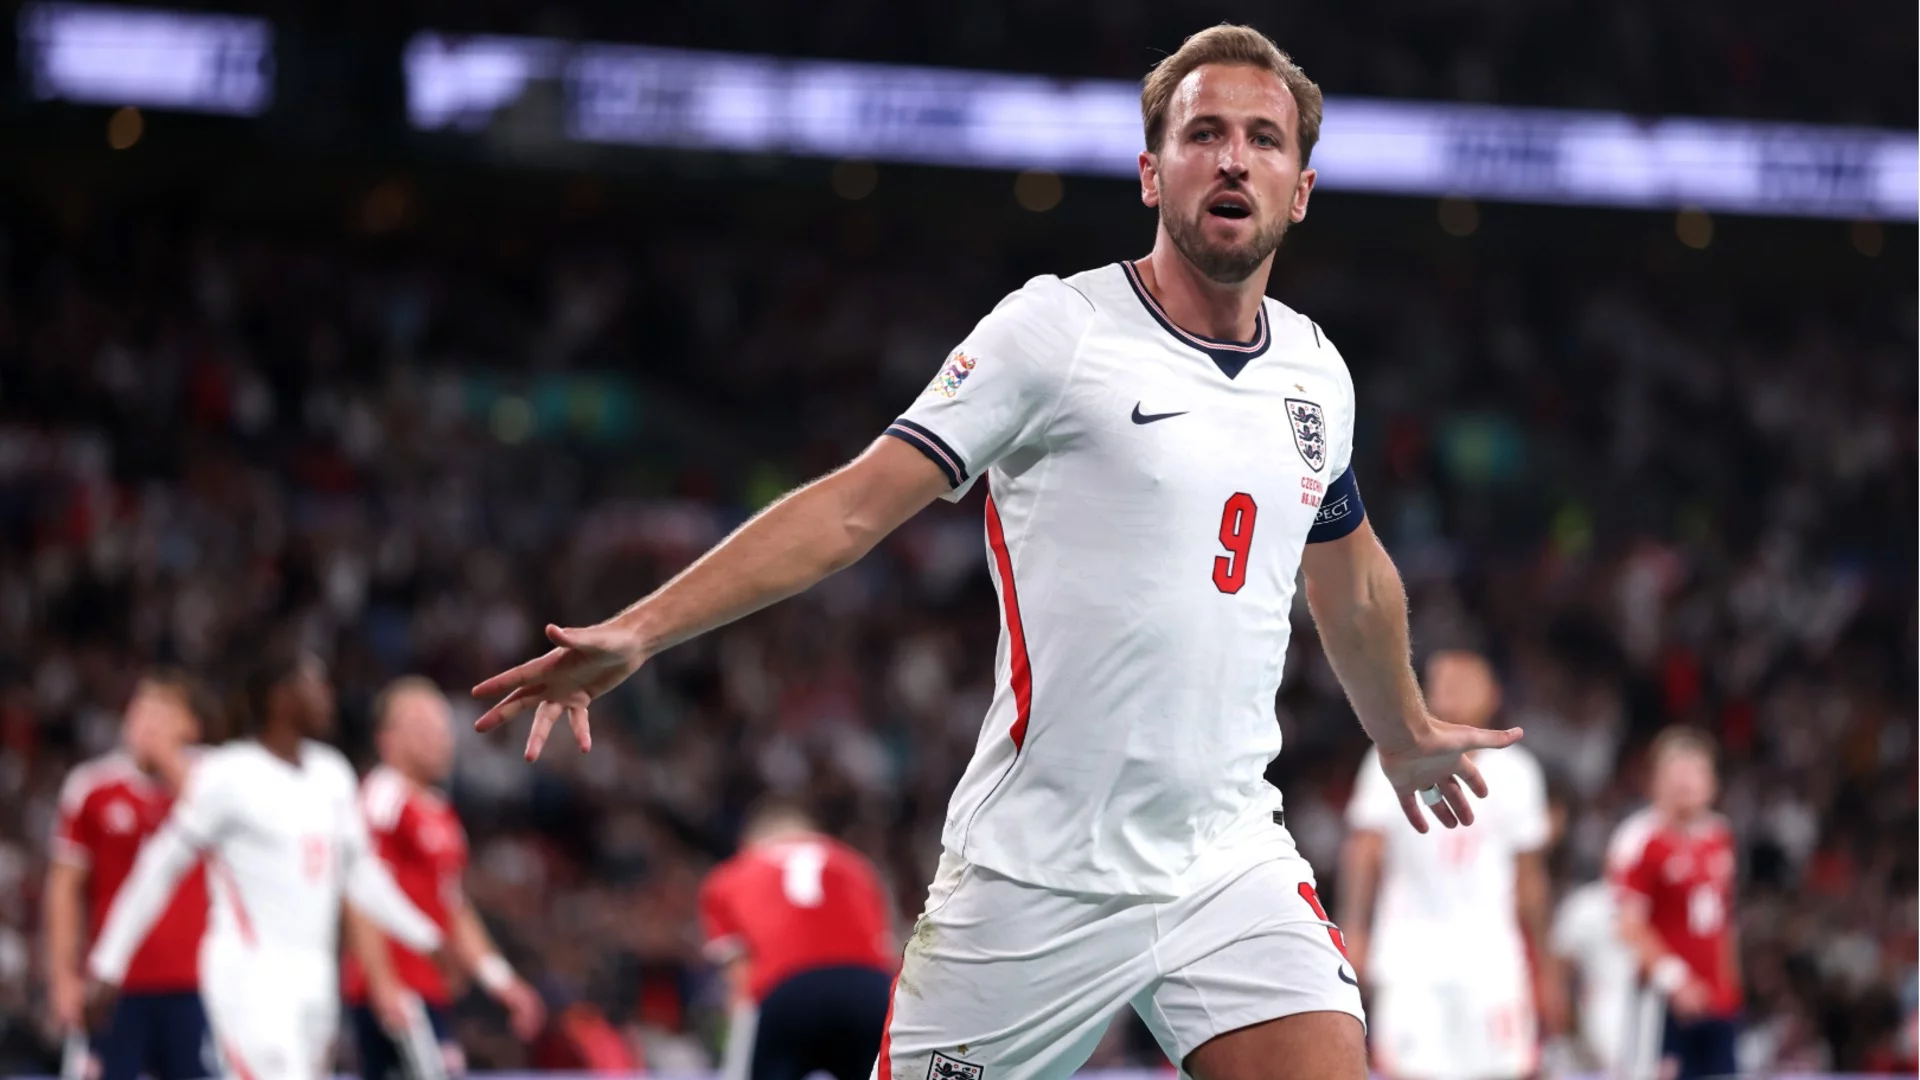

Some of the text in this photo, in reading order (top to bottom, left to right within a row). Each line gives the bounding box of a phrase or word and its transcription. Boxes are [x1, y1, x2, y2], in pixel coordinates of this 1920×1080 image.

[1301, 476, 1323, 494] CZECHI
[1315, 498, 1349, 521] PECT
[1212, 492, 1258, 594] 9
